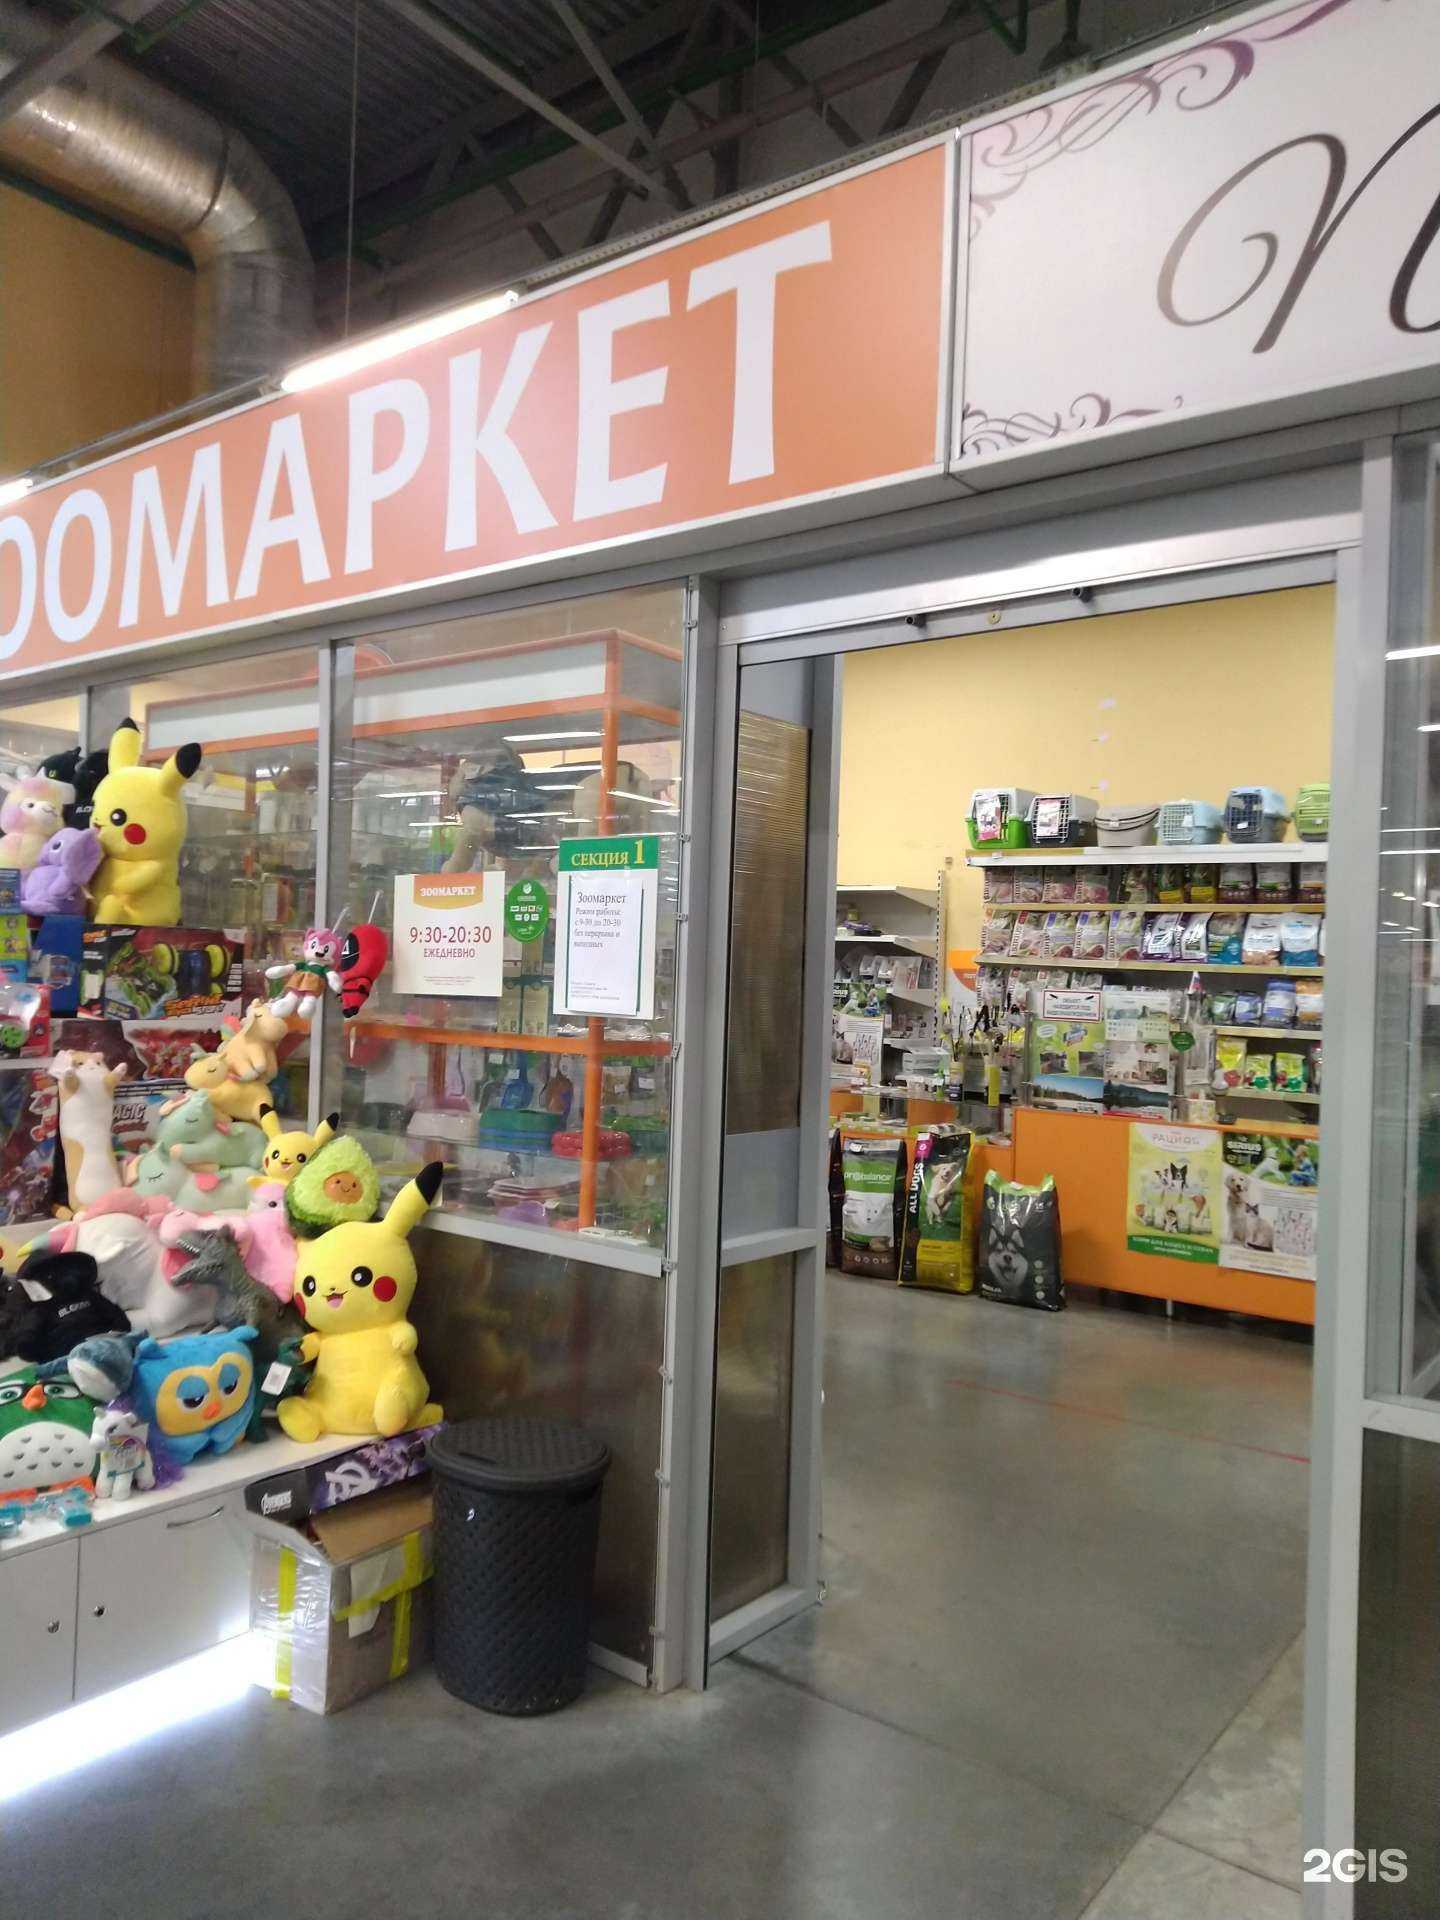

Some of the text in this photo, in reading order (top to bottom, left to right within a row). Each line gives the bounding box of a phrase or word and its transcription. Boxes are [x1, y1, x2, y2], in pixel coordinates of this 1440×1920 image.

[571, 839, 646, 868] СЕКЦИЯ 1
[420, 886, 476, 897] ЗООМАРКЕТ
[577, 891, 626, 906] Зоомаркет
[410, 926, 492, 943] 9:30-20:30
[424, 948, 476, 959] ЕЖЕДНЕВНО
[113, 1103, 146, 1119] AGIC
[909, 1192, 918, 1213] ALL
